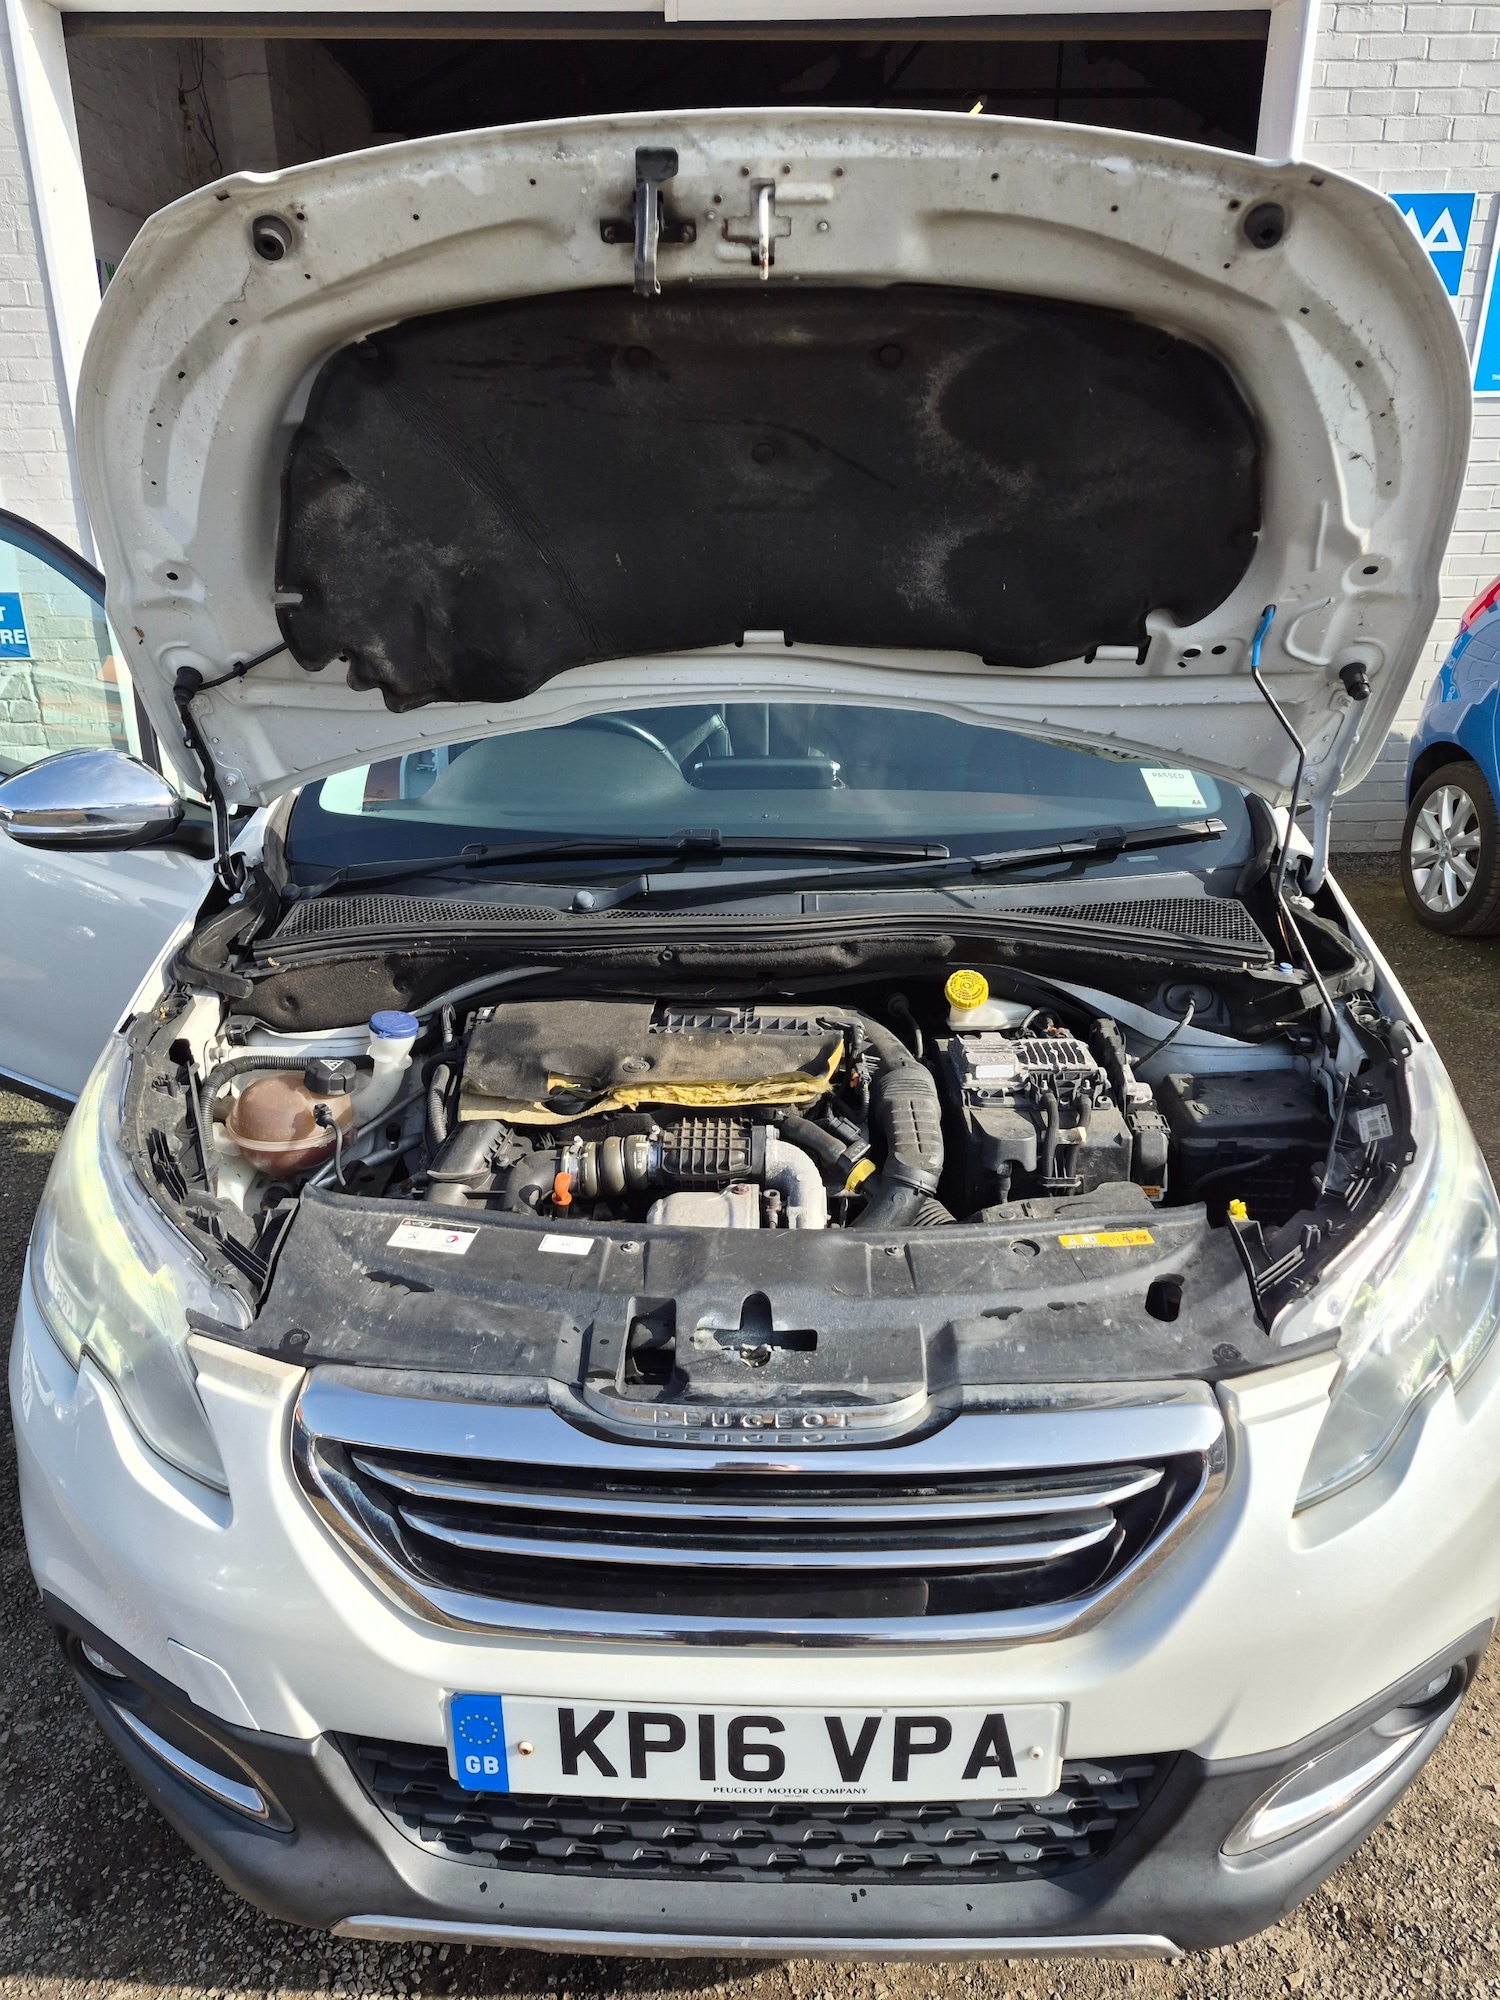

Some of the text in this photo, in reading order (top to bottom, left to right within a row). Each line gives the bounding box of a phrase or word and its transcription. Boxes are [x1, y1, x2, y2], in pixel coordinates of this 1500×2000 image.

[653, 1409, 853, 1428] PEUGEOT
[557, 1707, 1018, 1782] KP16 VPA
[464, 1755, 500, 1775] GB
[713, 1786, 764, 1794] PEUGEOT
[767, 1787, 809, 1795] MOTOR
